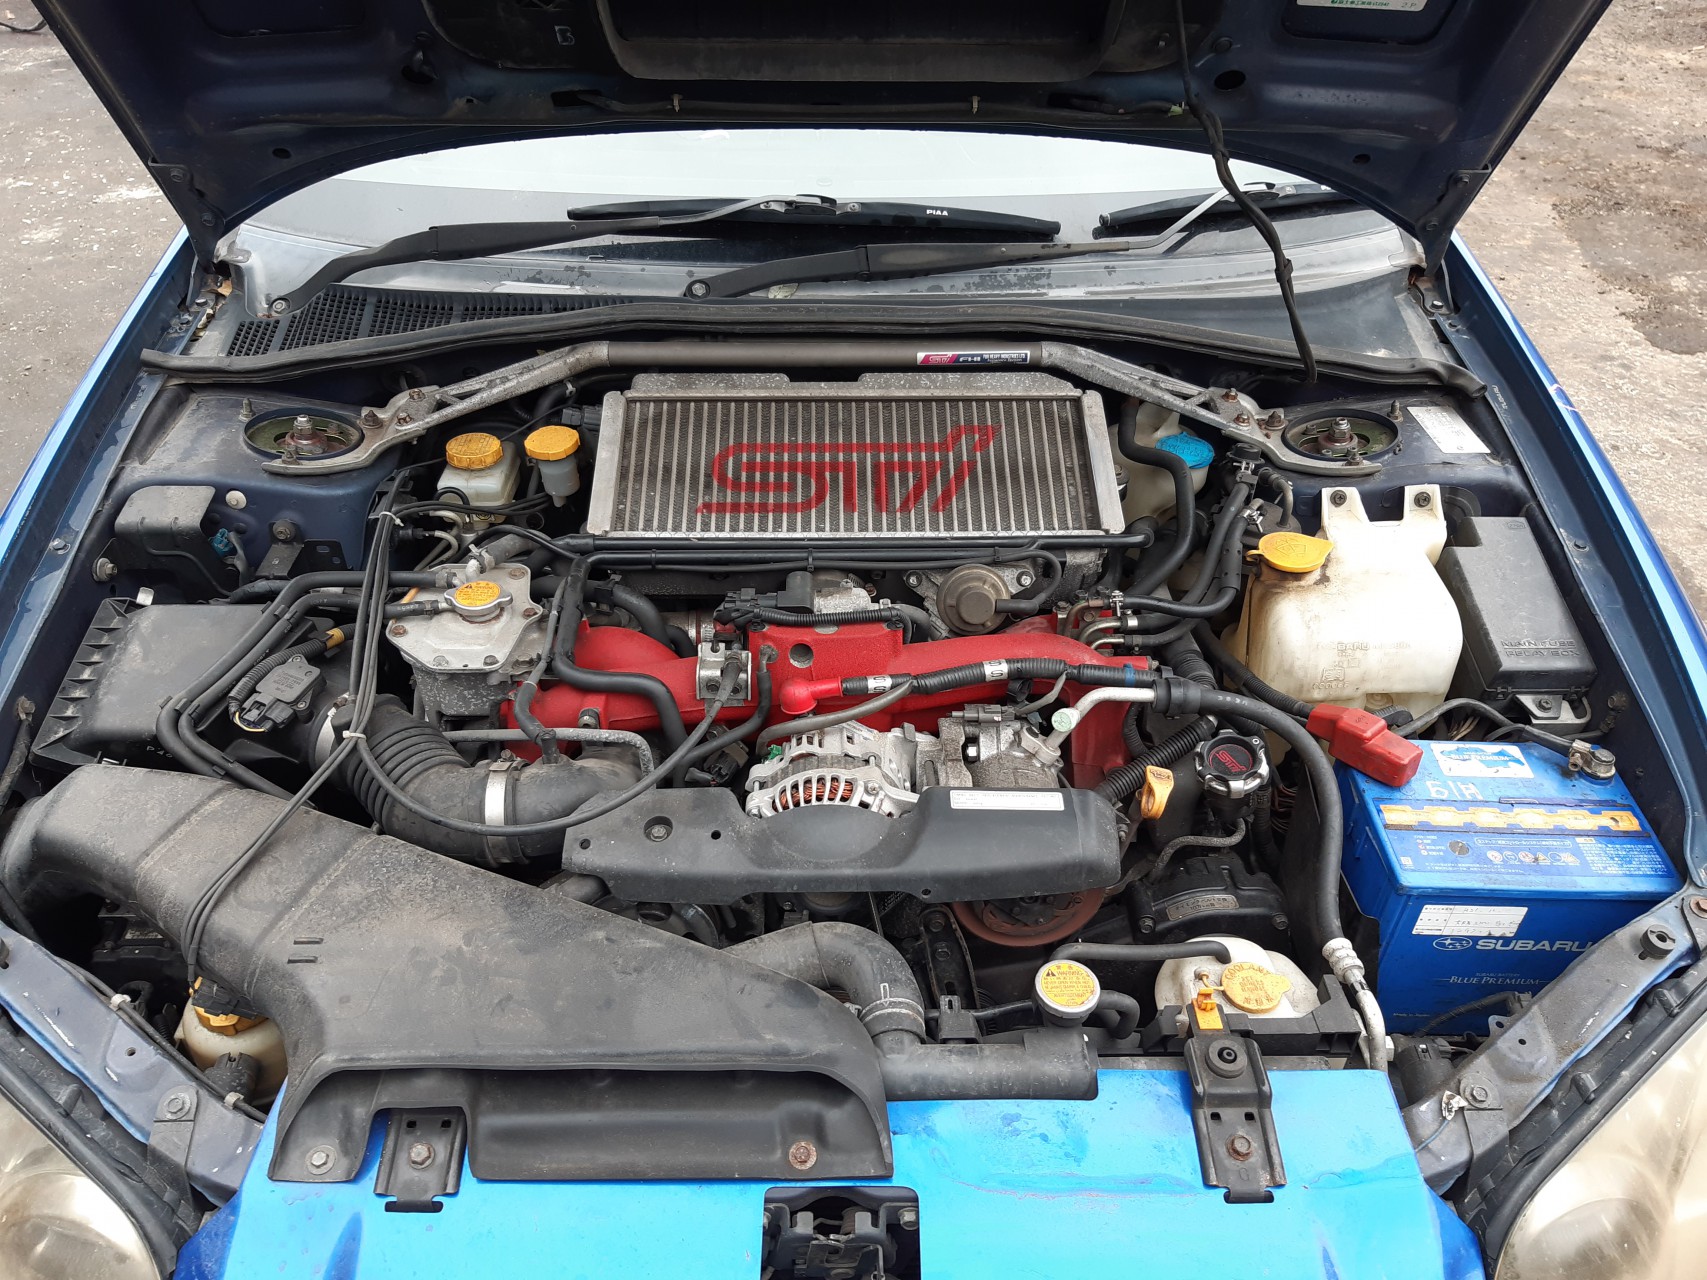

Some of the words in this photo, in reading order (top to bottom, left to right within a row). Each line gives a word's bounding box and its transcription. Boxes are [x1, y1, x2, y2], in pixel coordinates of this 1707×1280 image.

[926, 209, 949, 217] PIAA
[1501, 639, 1538, 647] MAIN
[1540, 639, 1576, 647] FUSE
[1475, 938, 1593, 952] SUBARU
[1450, 975, 1480, 984] BLUE
[1481, 976, 1540, 985] PREMIUM
